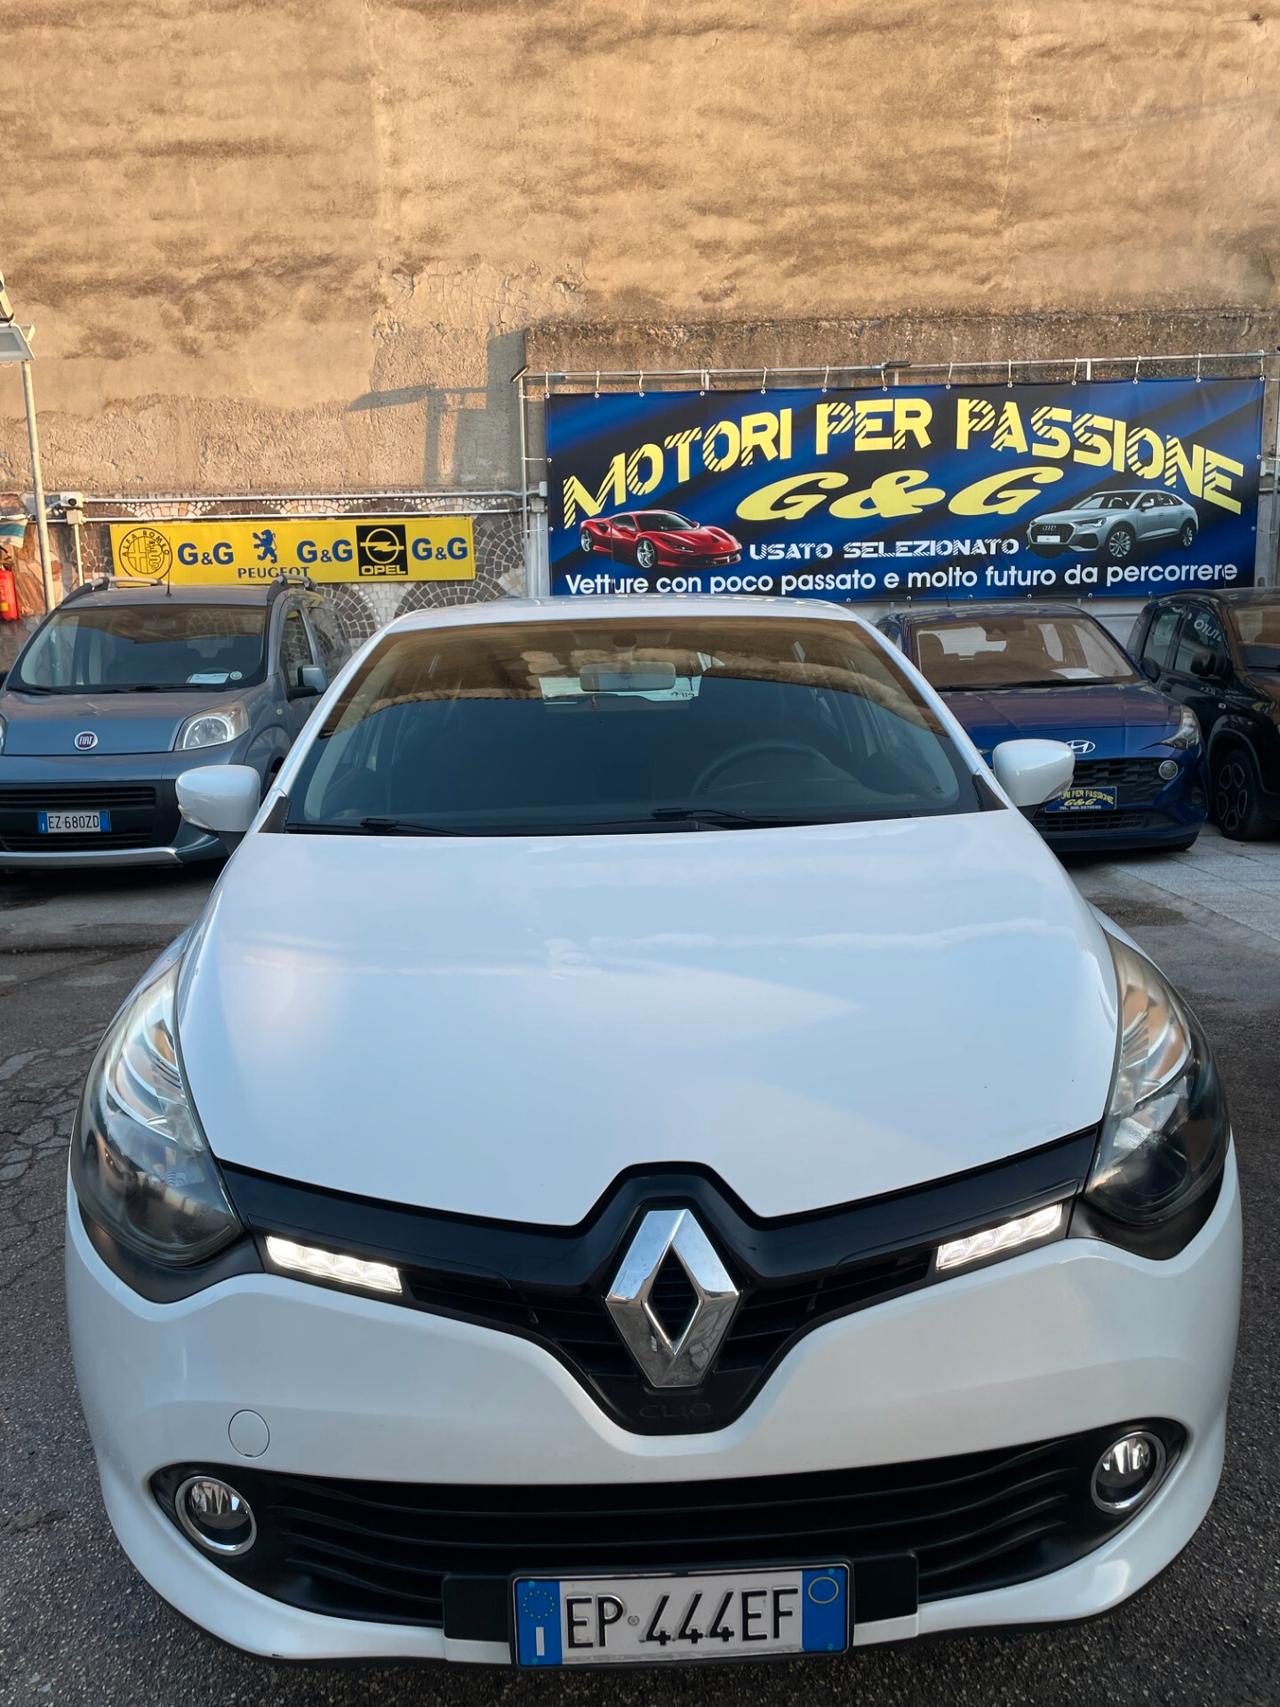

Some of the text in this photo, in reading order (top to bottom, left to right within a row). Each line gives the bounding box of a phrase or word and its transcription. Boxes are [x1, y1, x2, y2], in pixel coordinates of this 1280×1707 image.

[563, 398, 1244, 529] MOTORI PER PASSIONE
[736, 466, 1064, 521] G&G
[177, 542, 235, 566] G&G
[296, 539, 353, 563] G&G
[412, 537, 468, 561] G&G
[750, 538, 1019, 560] USATO SELEZIONATO
[361, 565, 407, 575] OPEL
[565, 563, 1238, 595] Vetture con poco passato e molto futuro da percorrere
[639, 1403, 712, 1419] CLIO
